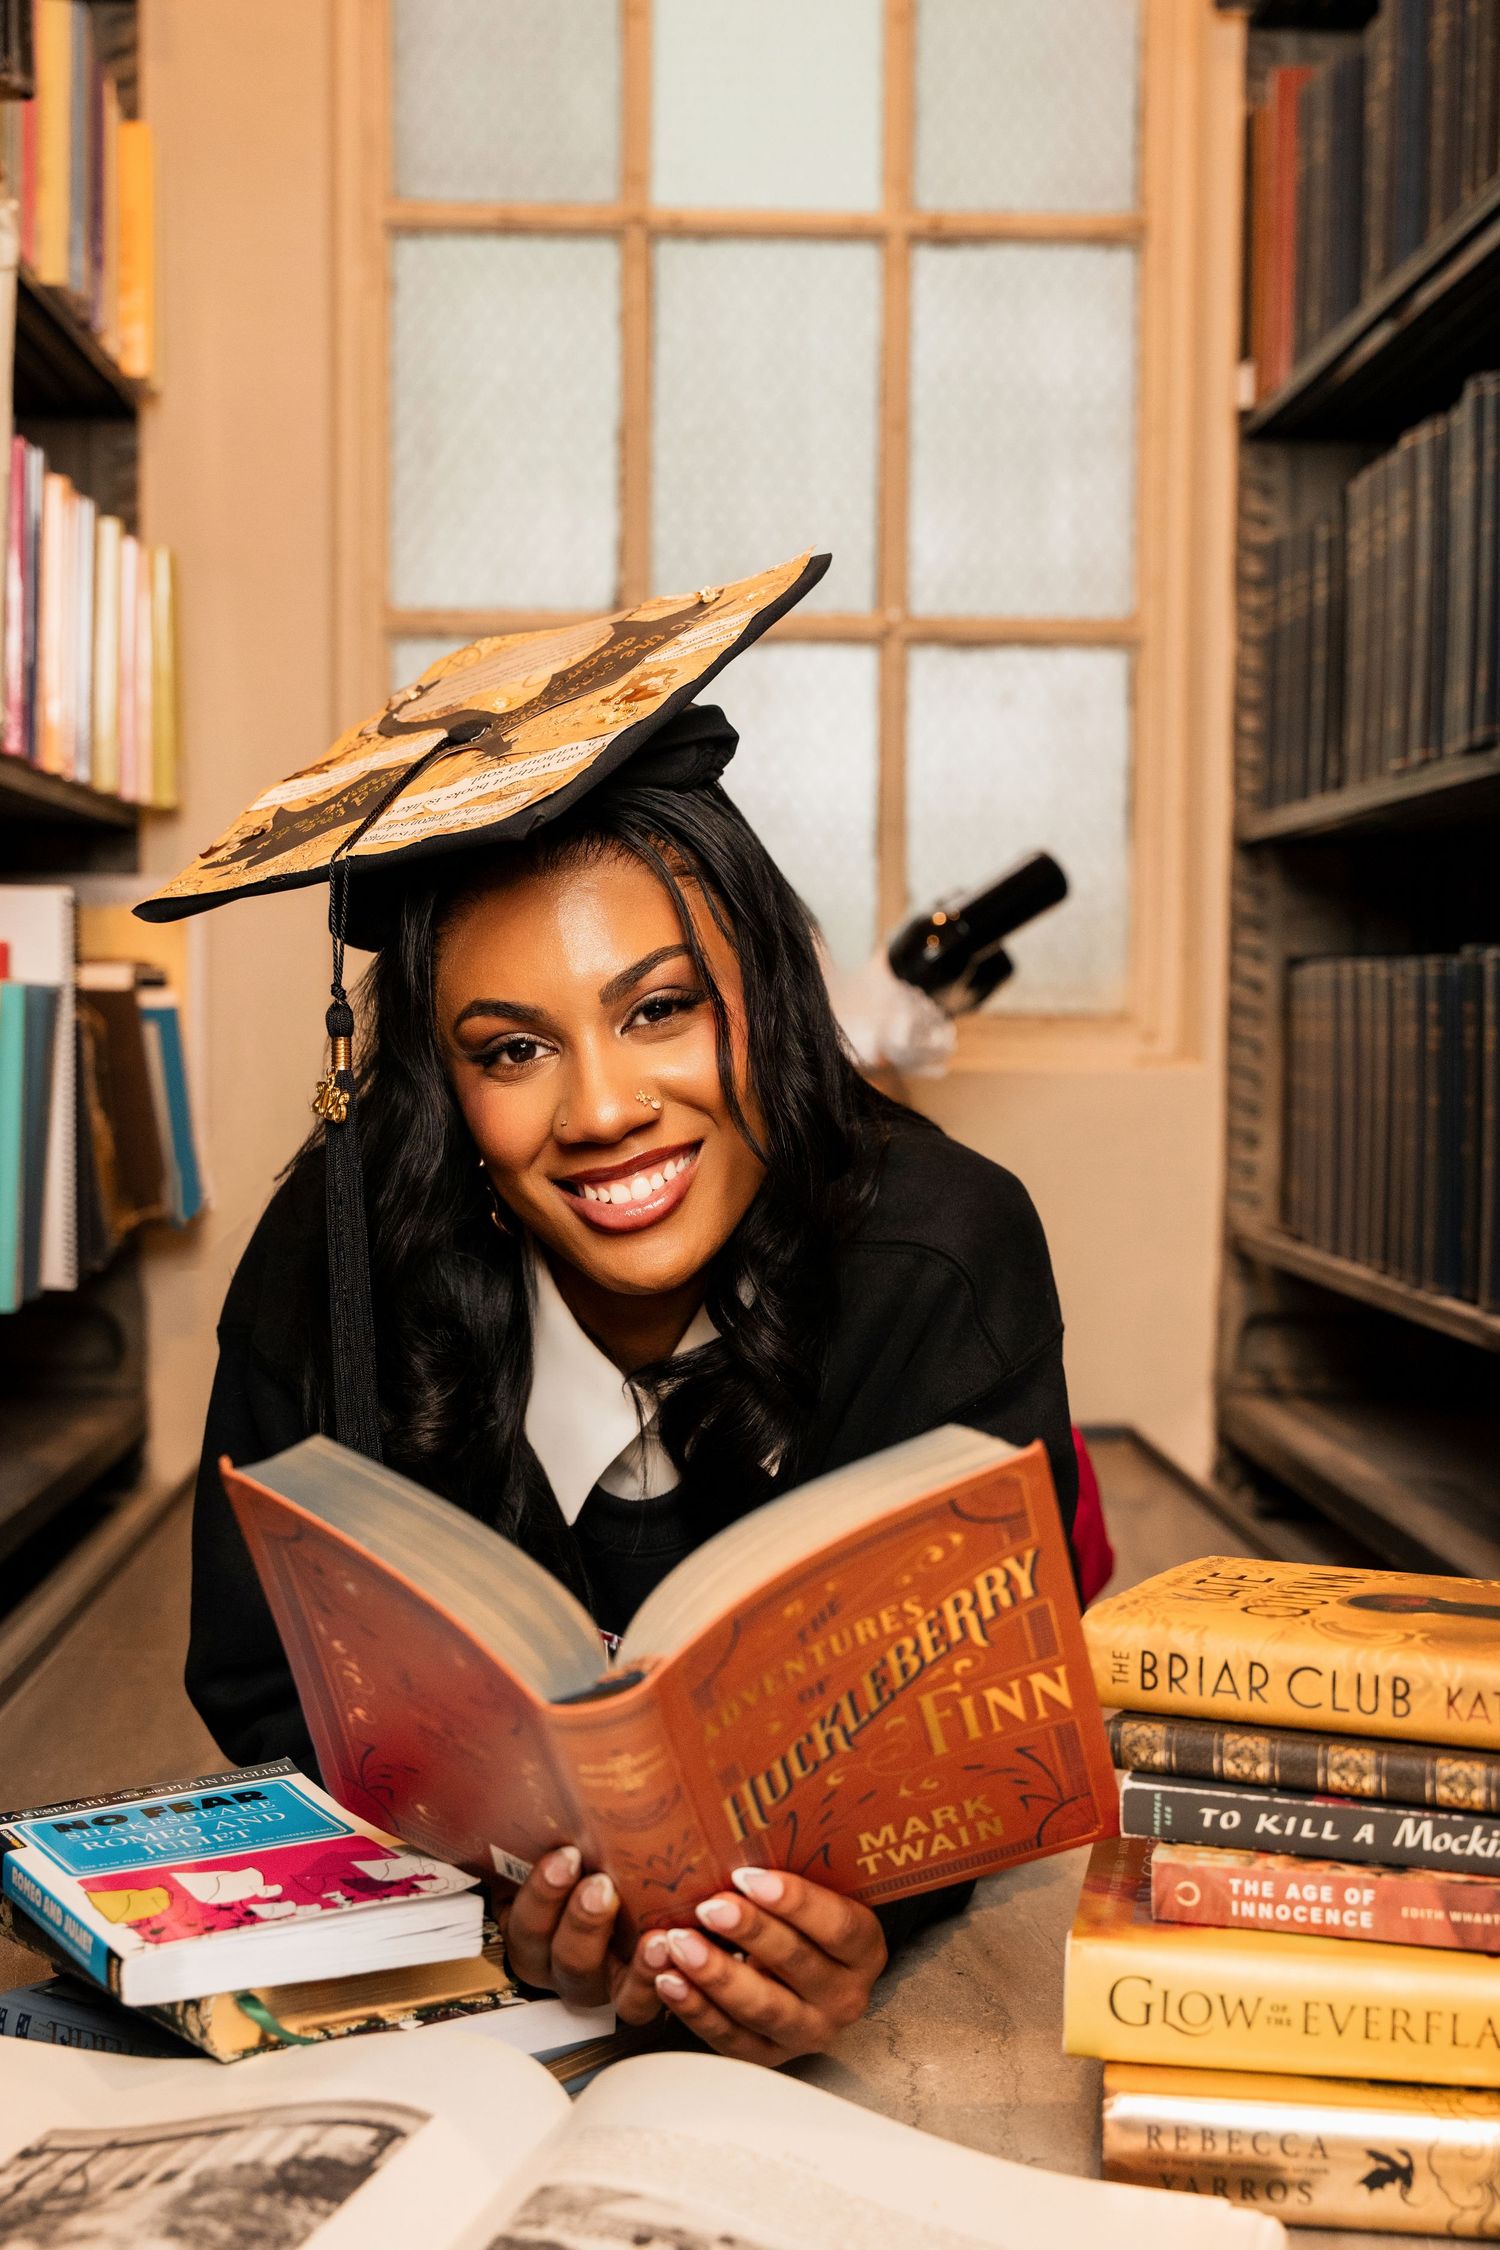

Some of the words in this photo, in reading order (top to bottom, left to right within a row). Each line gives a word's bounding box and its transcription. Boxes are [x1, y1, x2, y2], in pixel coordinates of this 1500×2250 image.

[619, 633, 664, 661] the
[445, 781, 488, 801] books
[1240, 1572, 1364, 1618] QUINN
[721, 1547, 1041, 1844] HUCKLEBERRY
[1111, 1649, 1131, 1684] THE
[1140, 1650, 1270, 1704] BRIAR
[1287, 1666, 1412, 1719] CLUB
[917, 1665, 1076, 1757] FINN
[167, 1778, 219, 1793] PLAIN
[221, 1764, 291, 1783] ENGLISH
[51, 1814, 129, 1833] NO
[142, 1790, 269, 1818] FEAR
[66, 1800, 276, 1840] SHAKESPEARE
[857, 1794, 995, 1853] MARK
[1199, 1808, 1241, 1830] TO
[1255, 1812, 1340, 1840] KILL
[1353, 1823, 1374, 1845] A
[82, 1822, 202, 1851] ROMEO
[215, 1811, 286, 1831] AND
[142, 1828, 251, 1855] JULIET
[856, 1814, 1005, 1877] TWAIN
[12, 1865, 42, 1903] ROMEO
[43, 1893, 63, 1928] AND
[63, 1913, 94, 1955] JULIET
[1229, 1878, 1274, 1899] THE
[1285, 1882, 1333, 1904] AGE
[1344, 1887, 1376, 1907] OF
[1231, 1901, 1374, 1929] INNOCENCE
[1401, 1906, 1445, 1921] EDITH
[1109, 1976, 1264, 2037] GLOW
[1265, 2015, 1292, 2027] THE
[1270, 2003, 1288, 2014] OF
[1302, 2000, 1500, 2050] EVERFLA
[1146, 2124, 1330, 2160] REBECCA
[1159, 2171, 1314, 2205] YARROS
